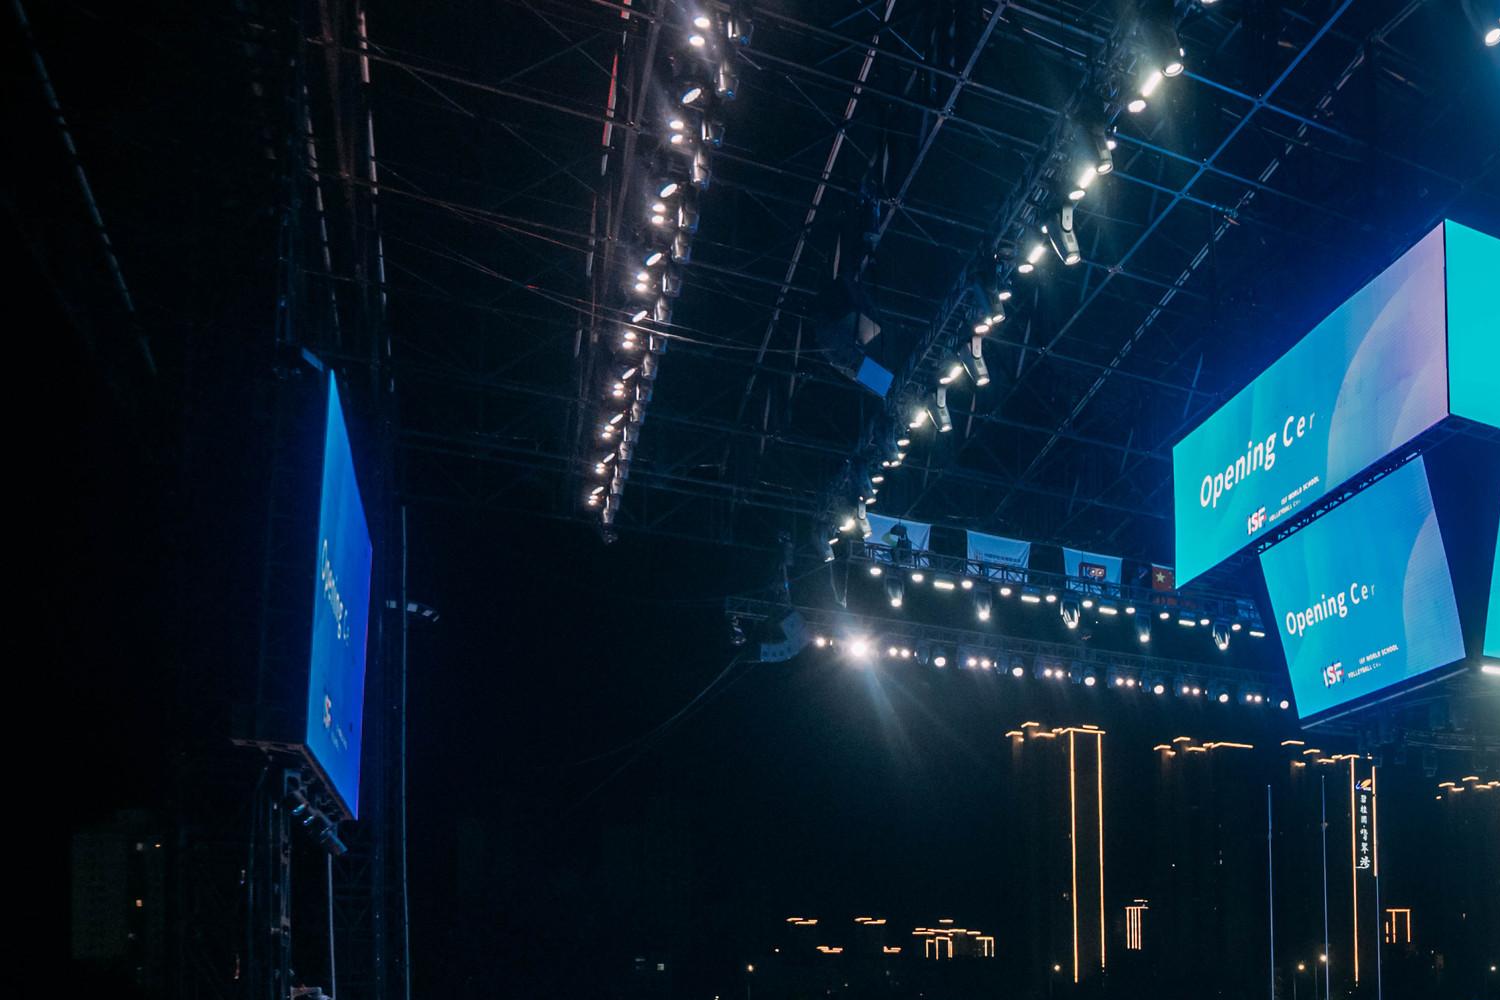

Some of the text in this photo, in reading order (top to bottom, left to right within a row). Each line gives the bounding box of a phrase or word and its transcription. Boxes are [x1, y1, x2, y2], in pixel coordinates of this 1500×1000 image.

[1200, 431, 1277, 508] Opening
[1247, 506, 1267, 535] ISF
[1285, 591, 1348, 638] Opening
[1323, 662, 1344, 689] ISF
